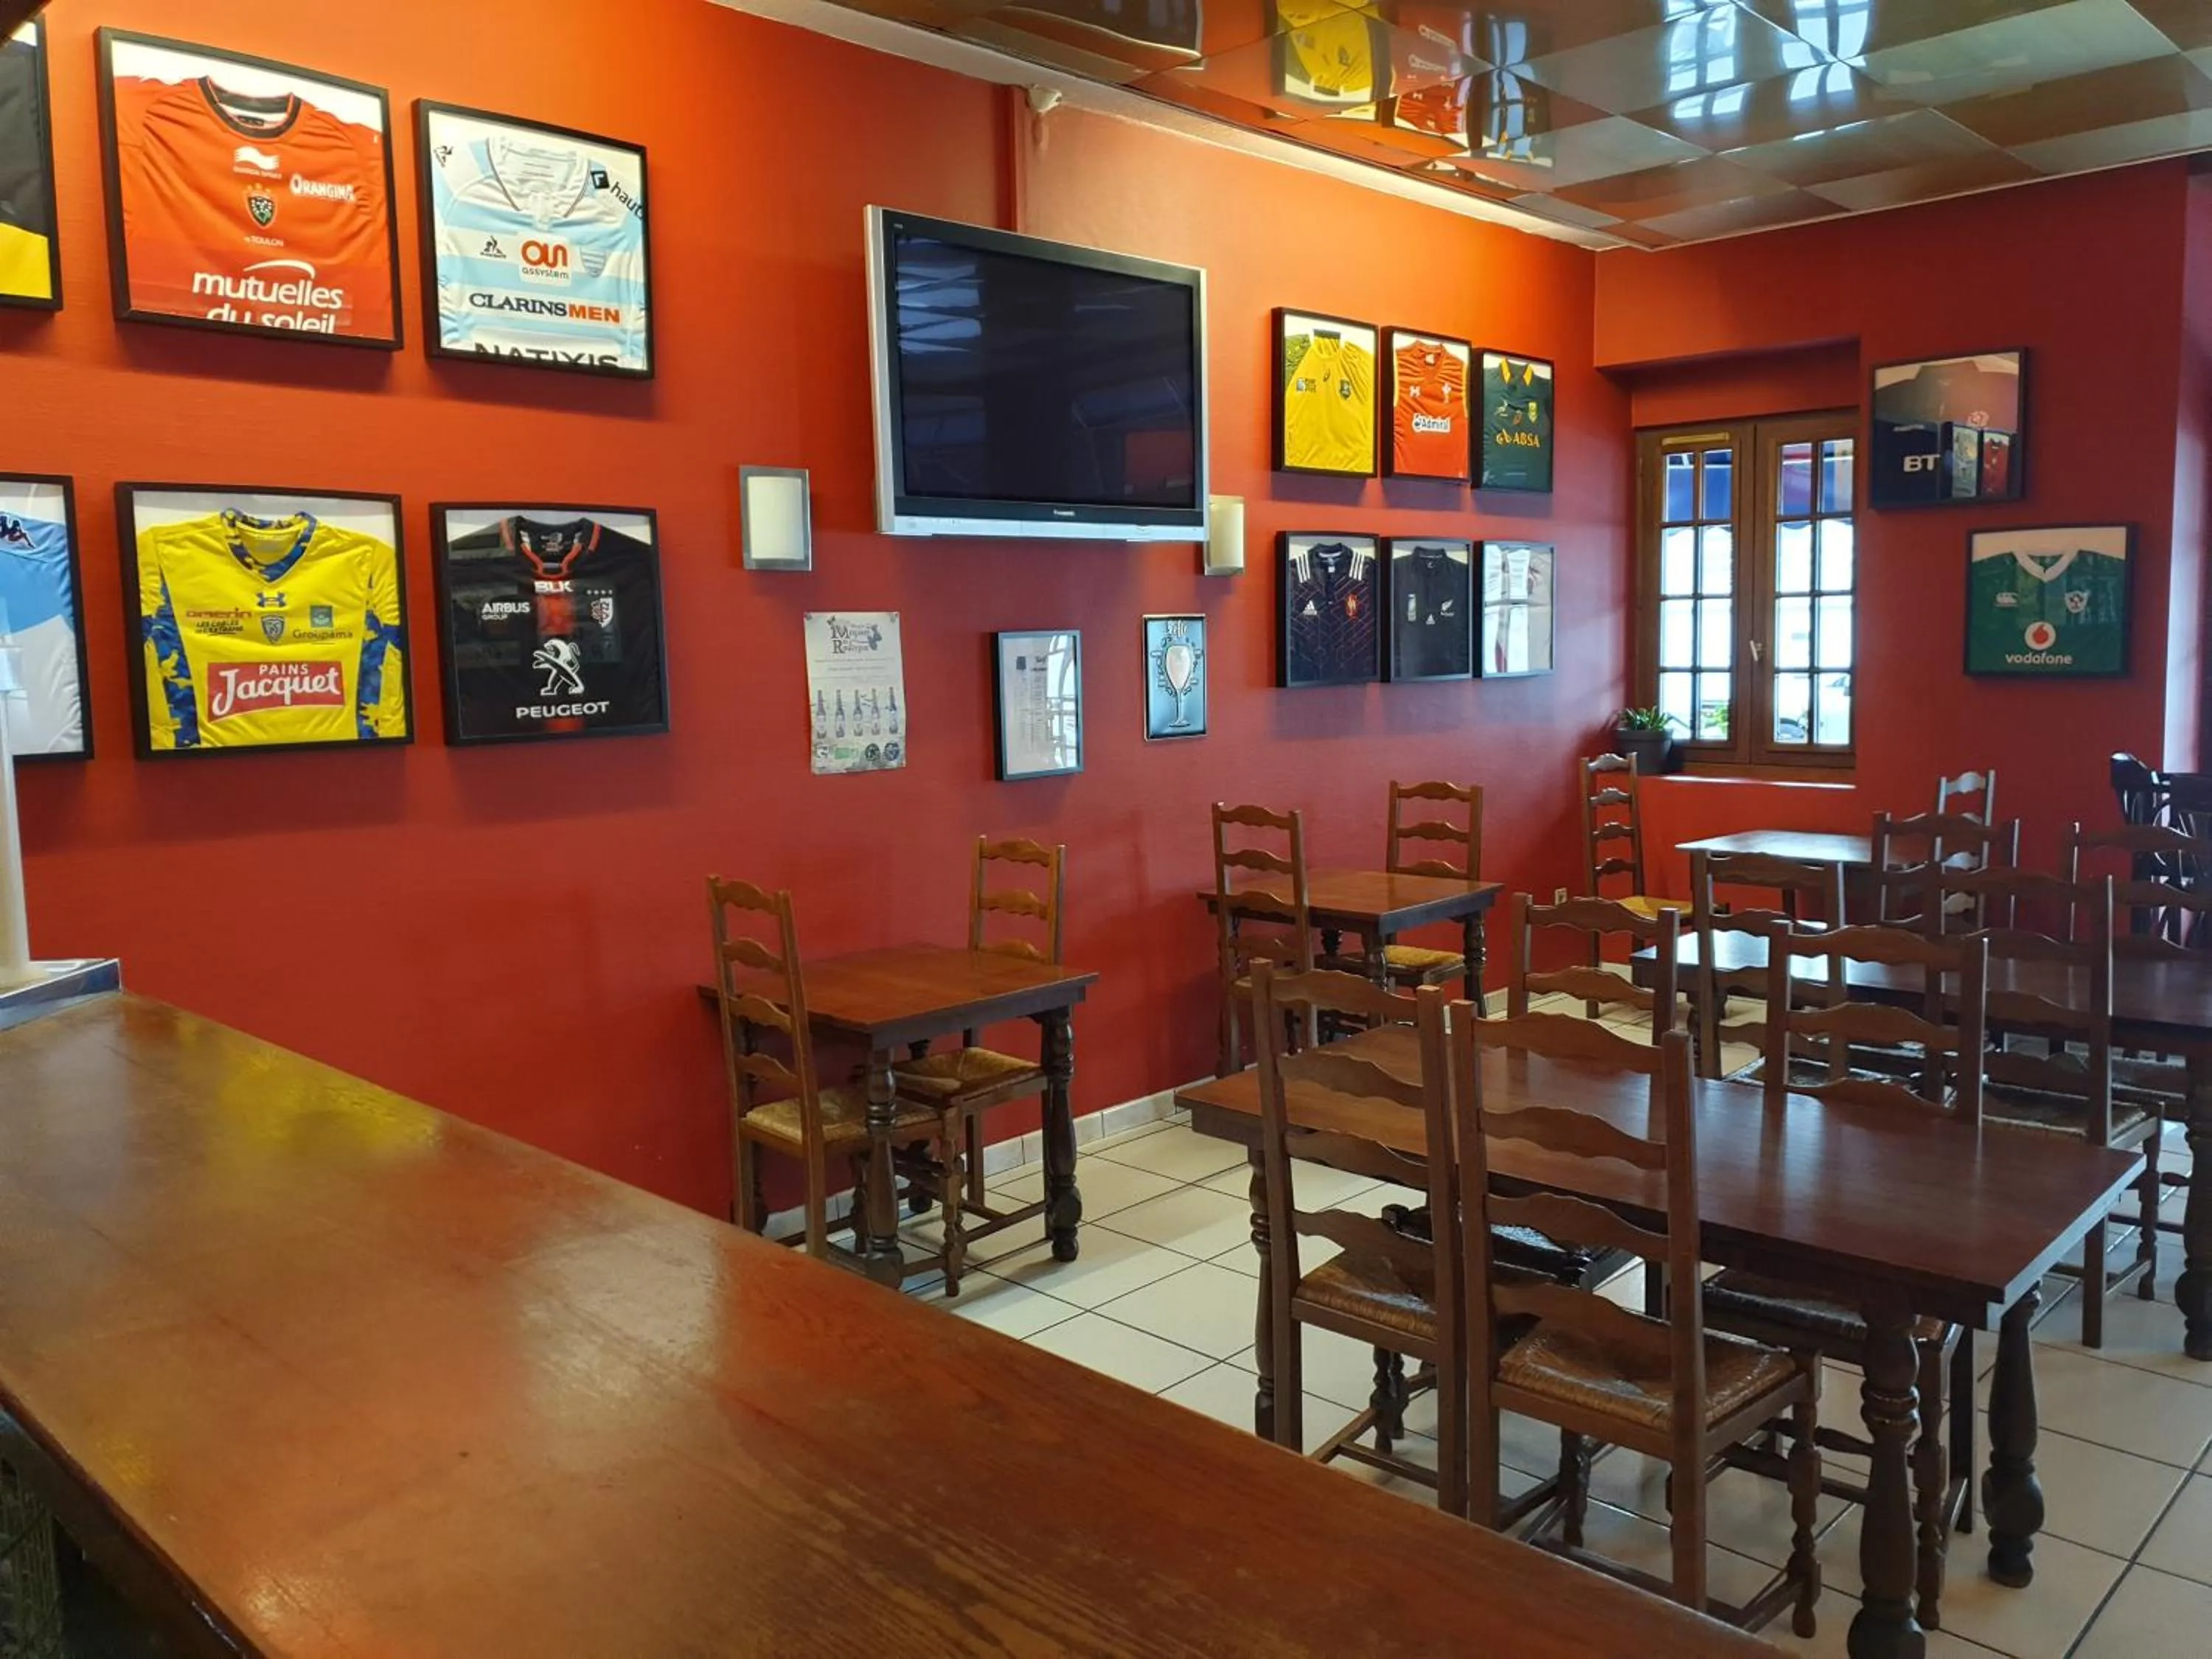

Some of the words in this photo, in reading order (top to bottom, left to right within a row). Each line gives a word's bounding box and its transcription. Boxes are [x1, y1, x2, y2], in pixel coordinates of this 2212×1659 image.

[289, 173, 356, 202] ORANGINA
[522, 266, 569, 279] assystem
[192, 271, 344, 309] mutuelles
[1903, 453, 1941, 472] BT
[534, 580, 574, 593] BLK
[481, 602, 531, 613] AIRBUS
[2005, 651, 2073, 664] vodafone
[259, 664, 309, 675] PAINS
[212, 667, 341, 716] Jacquet
[516, 700, 610, 719] PEUGEOT
